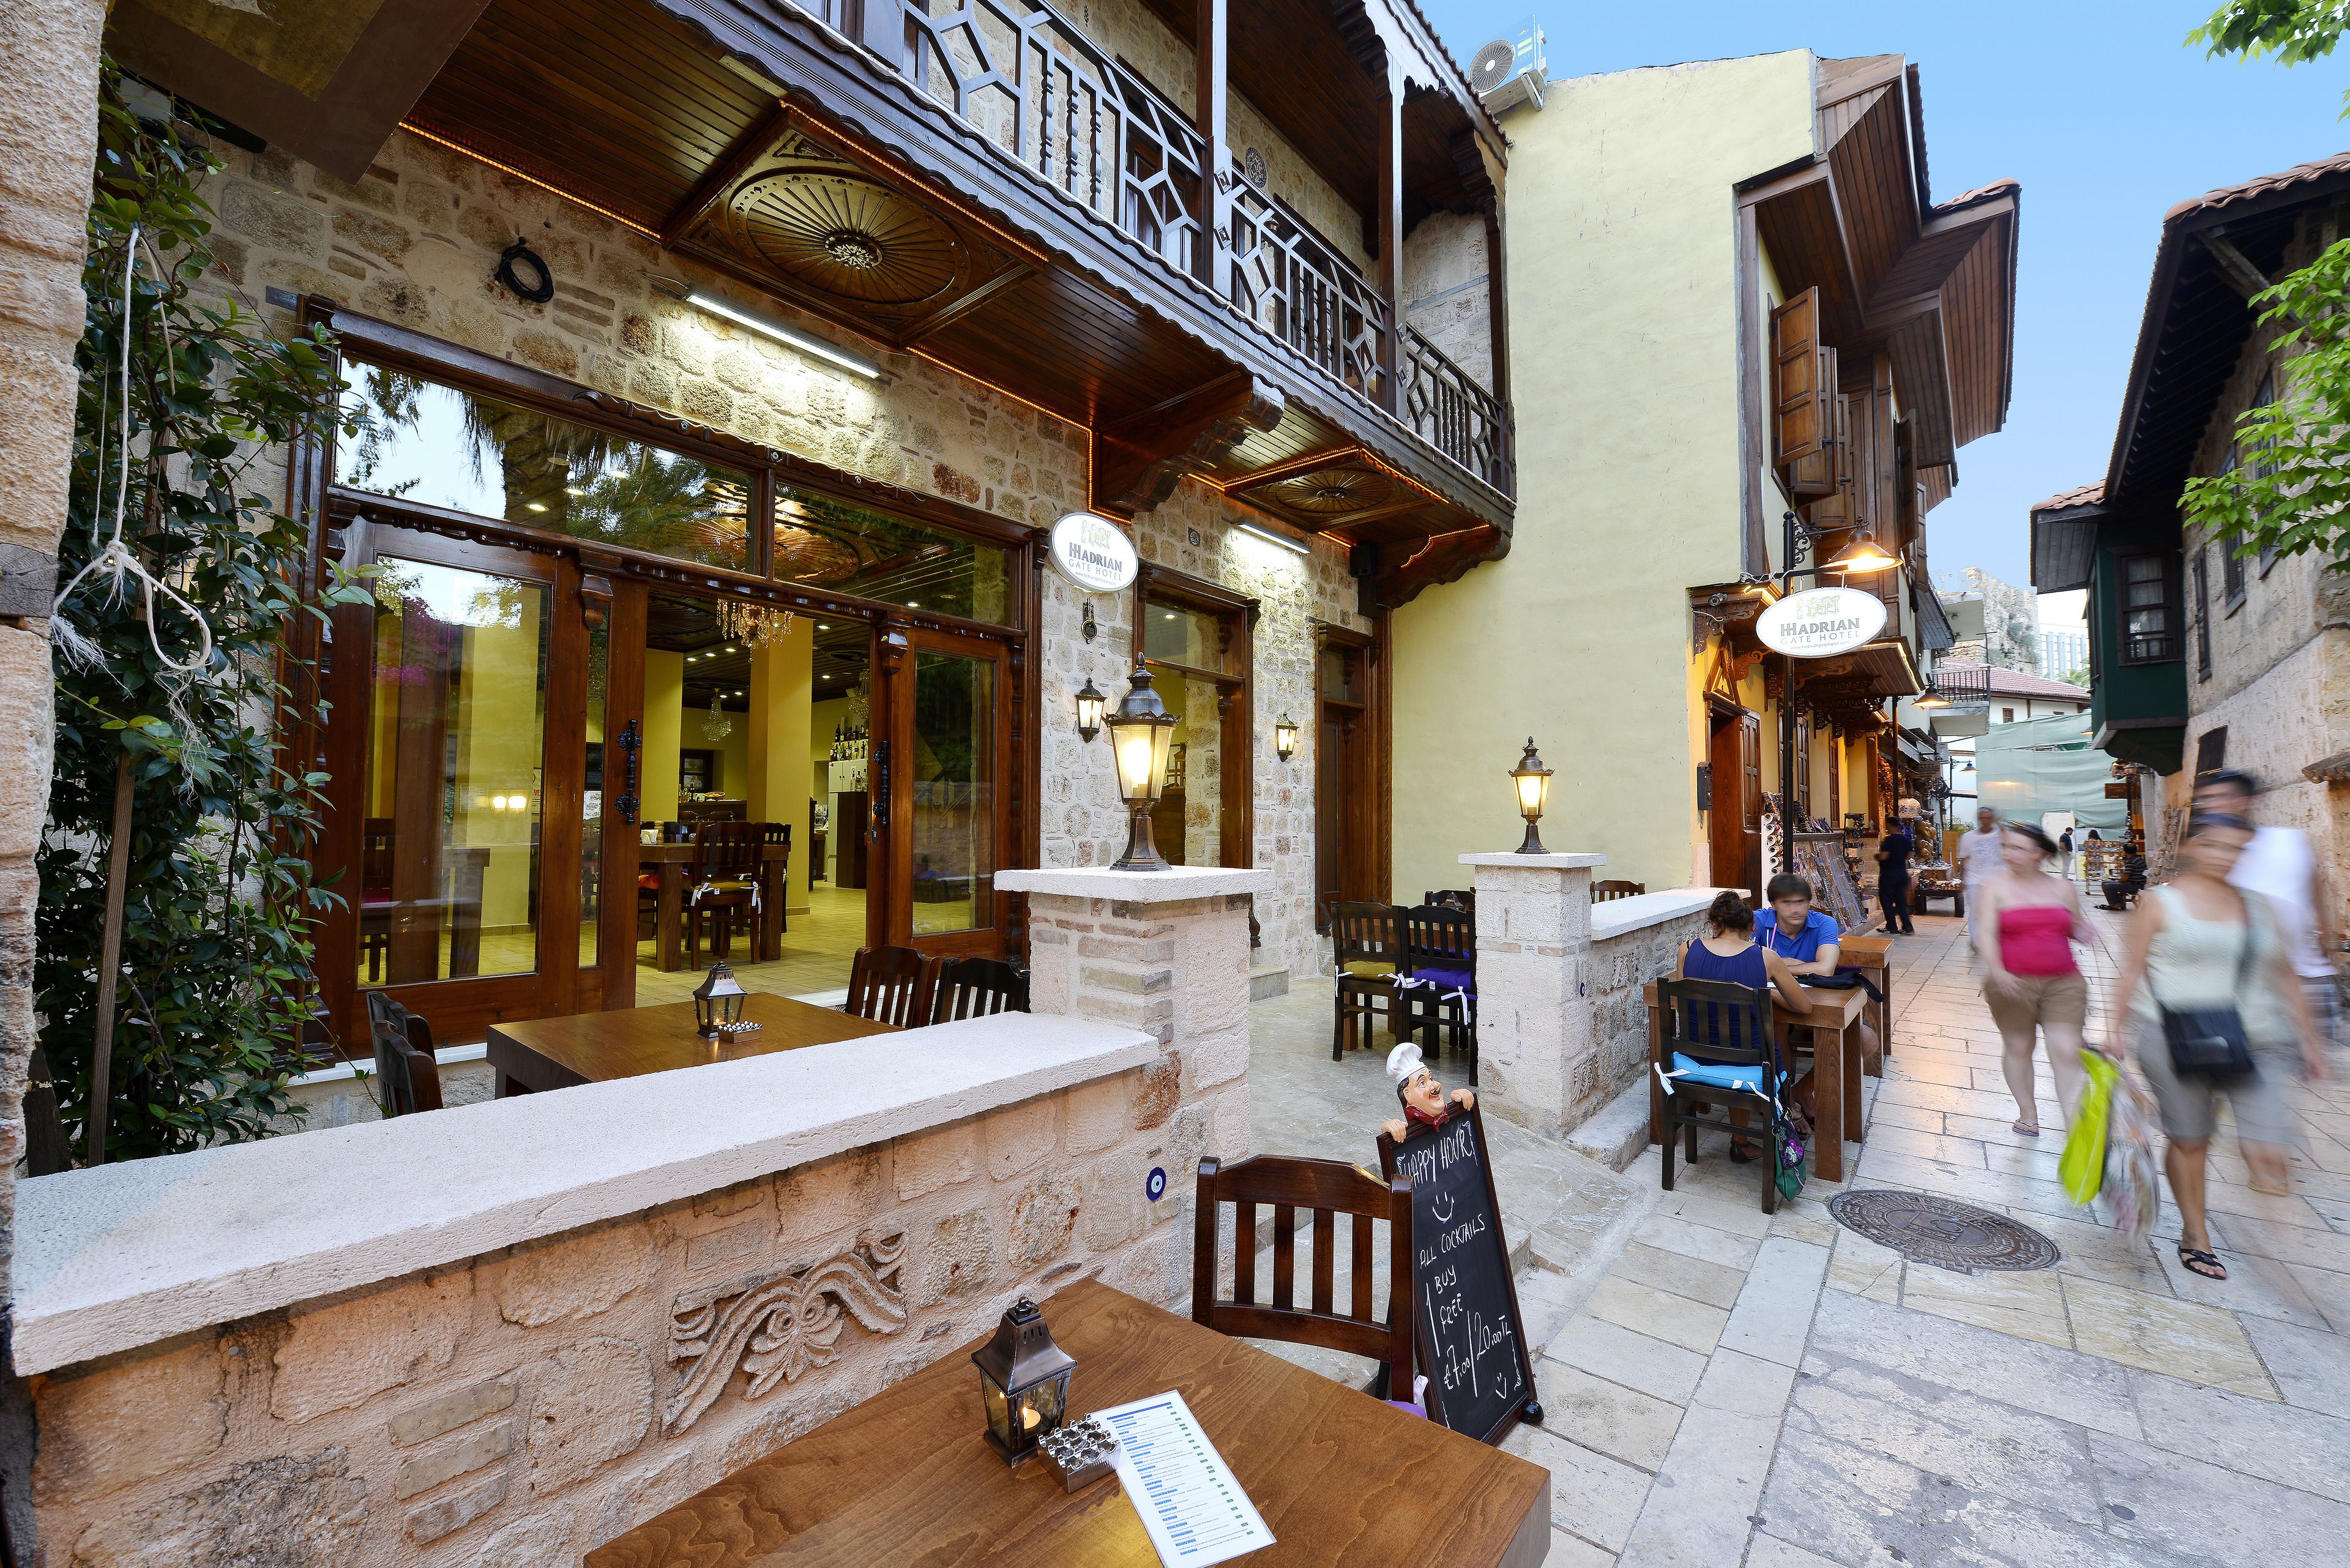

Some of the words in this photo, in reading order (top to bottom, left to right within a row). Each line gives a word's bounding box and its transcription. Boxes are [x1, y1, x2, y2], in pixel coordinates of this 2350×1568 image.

[1069, 559, 1091, 572] GATE
[1096, 567, 1122, 581] HOTEL
[1780, 635, 1811, 645] GATE
[1819, 631, 1860, 641] HOTEL
[1440, 1128, 1472, 1170] HOUR
[1420, 1245, 1437, 1270] ALL
[1441, 1214, 1485, 1253] COCKTAILS
[1434, 1264, 1457, 1294] BUY
